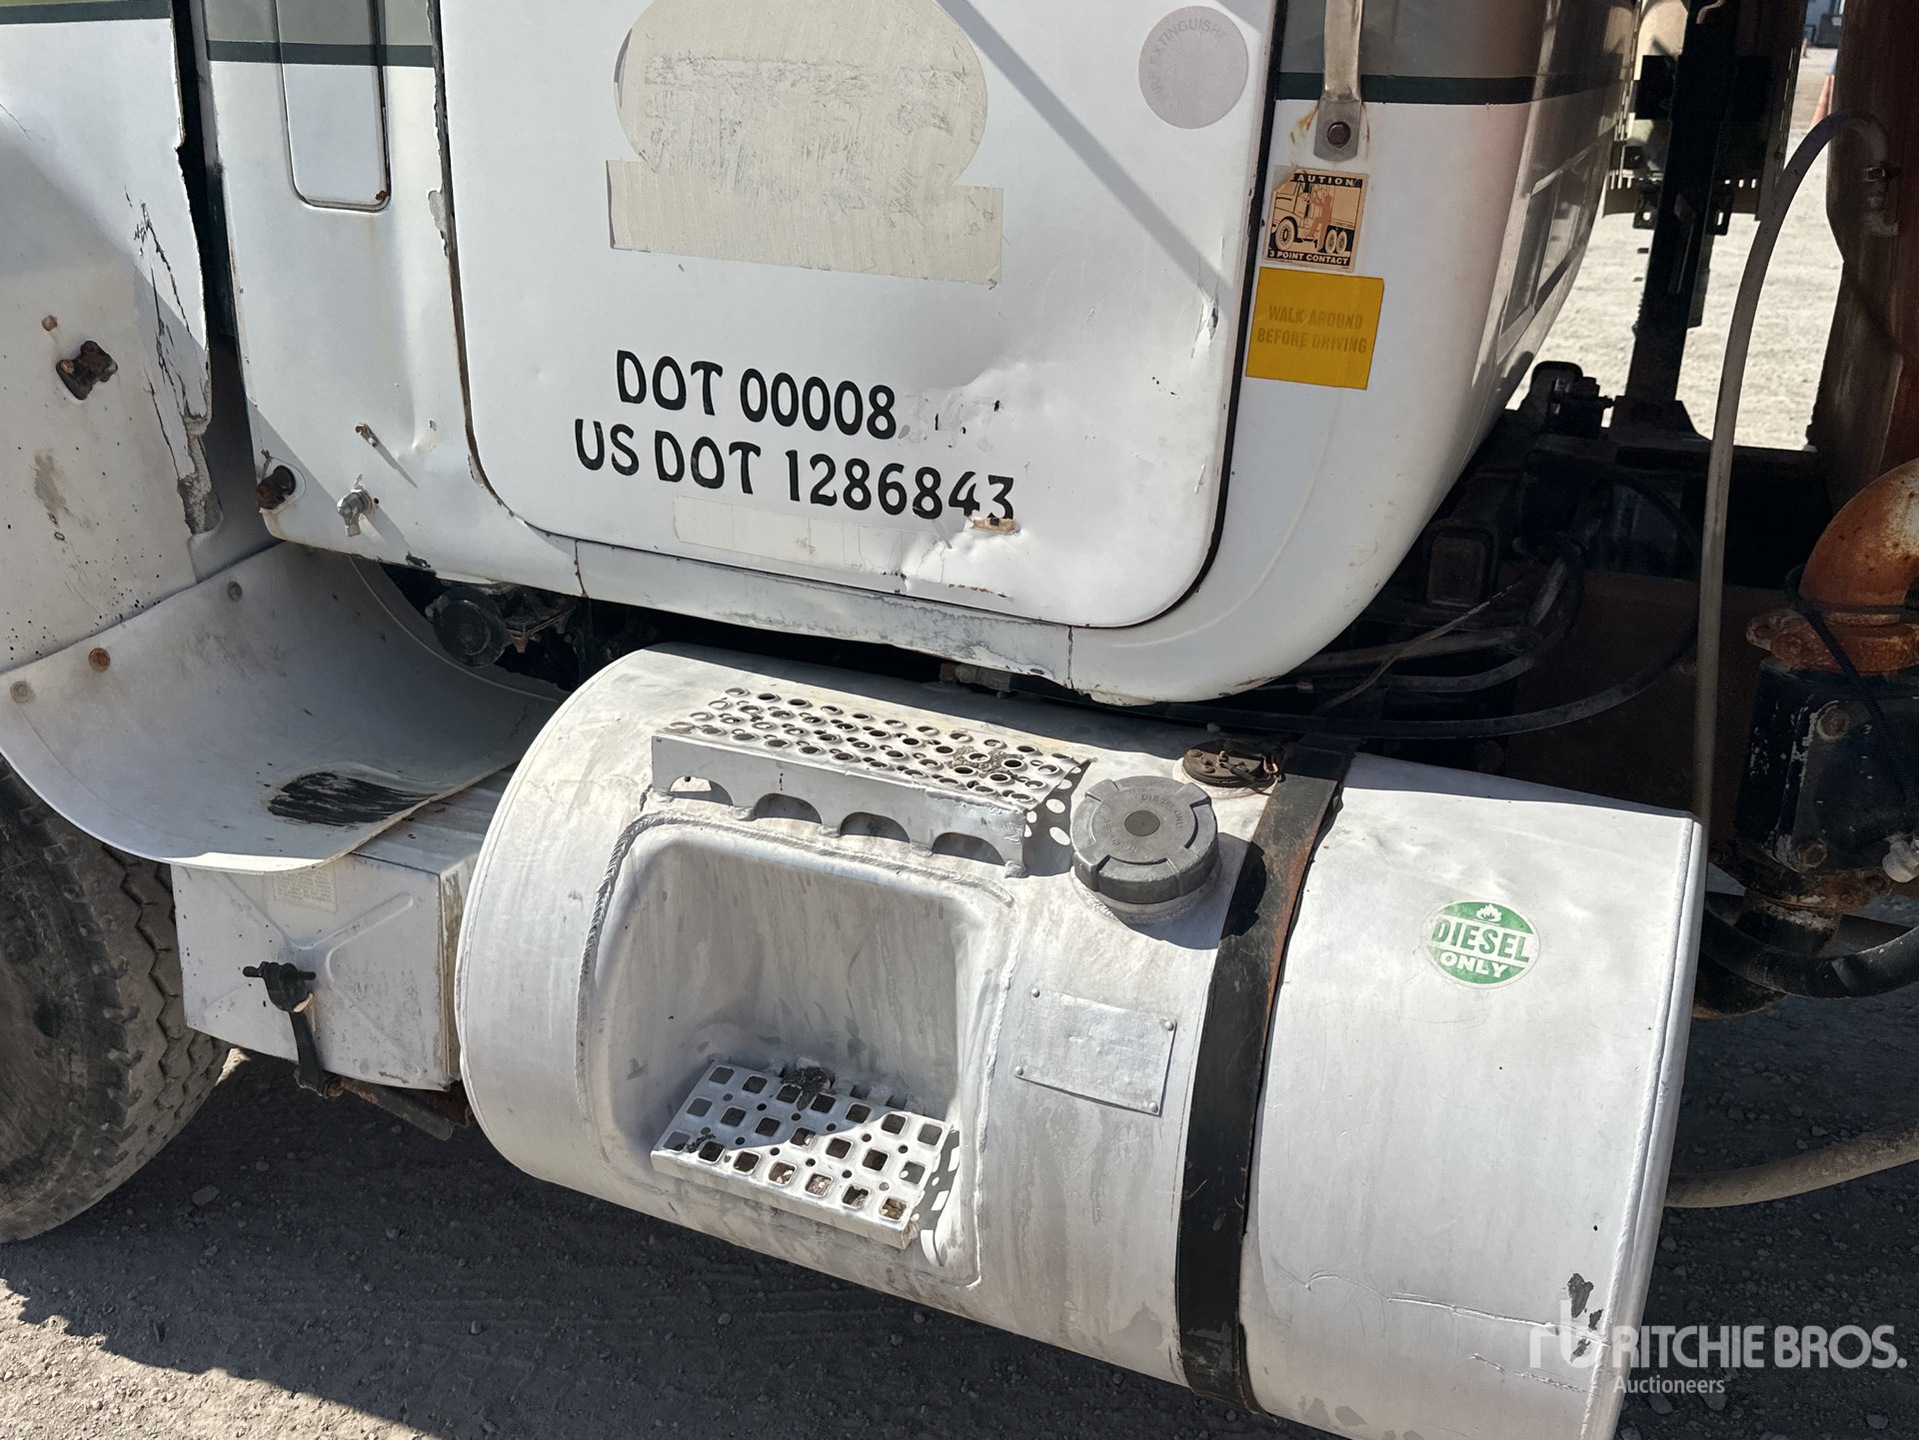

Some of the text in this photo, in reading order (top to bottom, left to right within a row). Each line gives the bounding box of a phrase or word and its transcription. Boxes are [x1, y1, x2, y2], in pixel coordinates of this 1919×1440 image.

[1292, 174, 1356, 187] AUTION
[1269, 250, 1349, 265] 3 POINT CONTACT
[1268, 305, 1363, 330] WALK AROUND
[1256, 327, 1367, 354] BEFORE DRIVING
[617, 349, 897, 440] DOT 00008
[574, 418, 1015, 522] US DOT 1286843
[1431, 919, 1530, 963] DIESEL
[1440, 951, 1511, 978] ONLY
